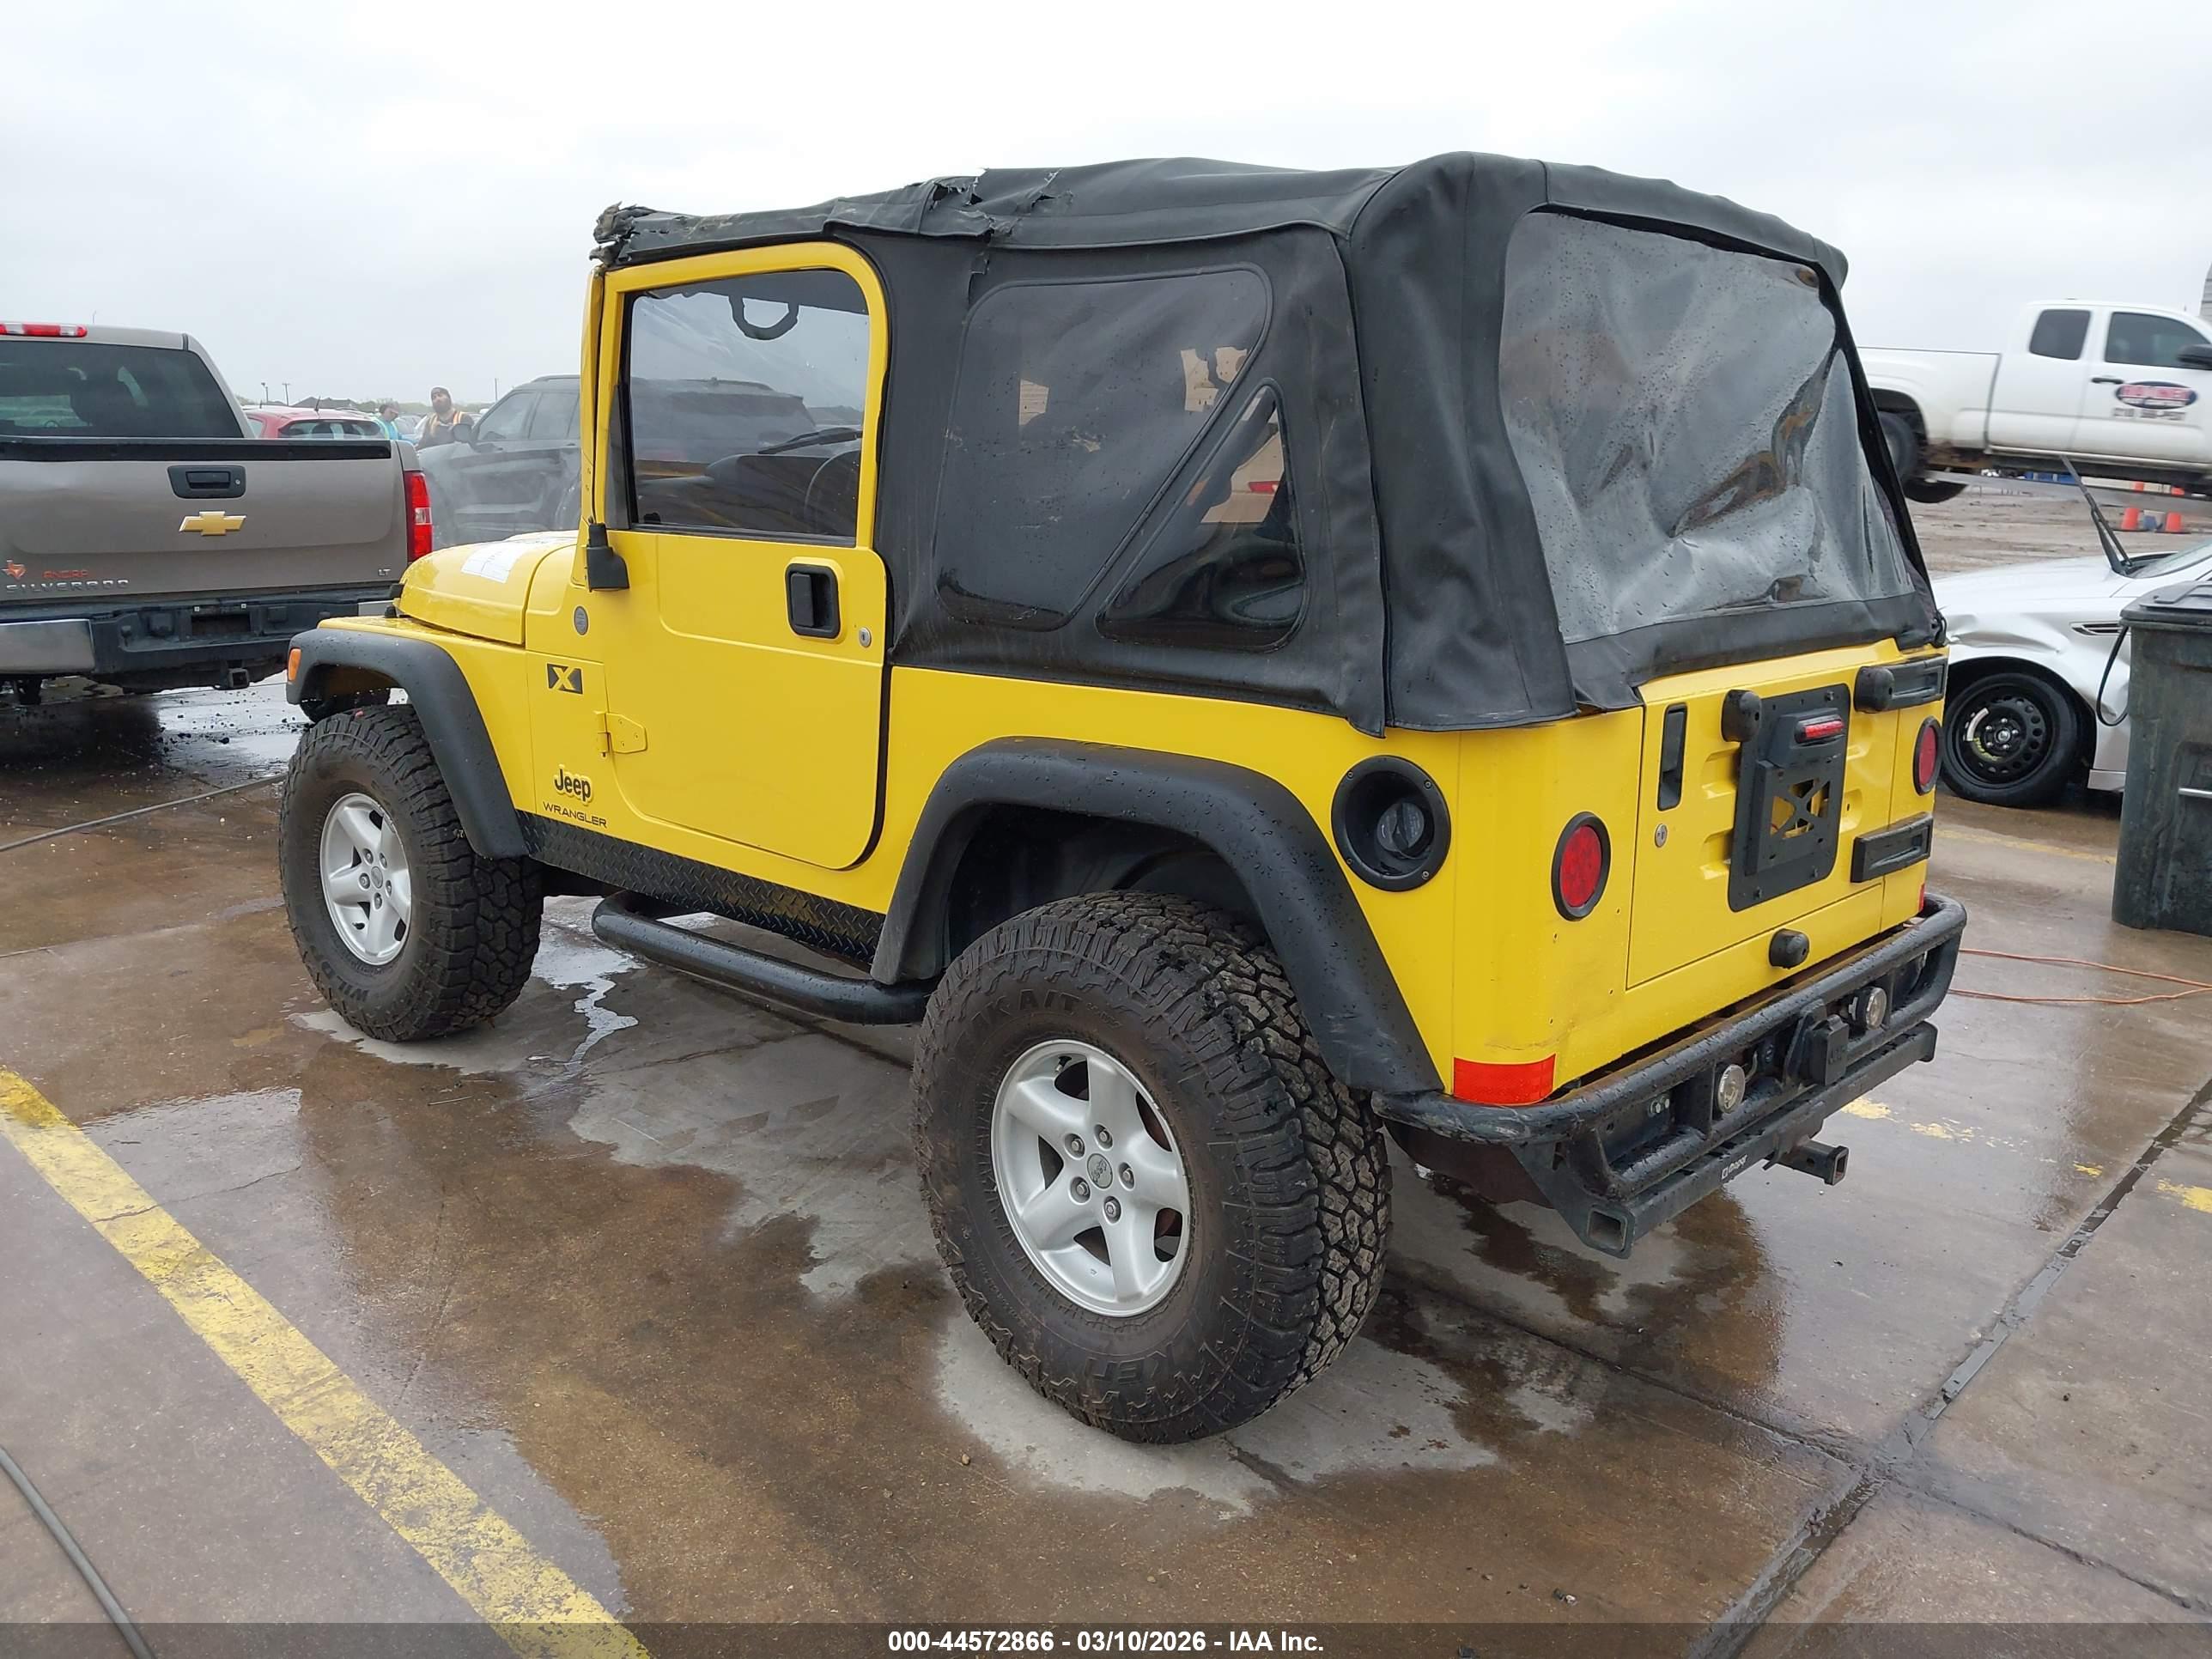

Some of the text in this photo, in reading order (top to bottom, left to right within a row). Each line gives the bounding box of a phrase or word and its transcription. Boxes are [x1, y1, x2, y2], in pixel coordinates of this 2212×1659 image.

[6, 579, 129, 593] SILVERADO
[549, 665, 579, 692] X
[553, 768, 592, 802] Jeep
[543, 800, 608, 829] WRANGLER
